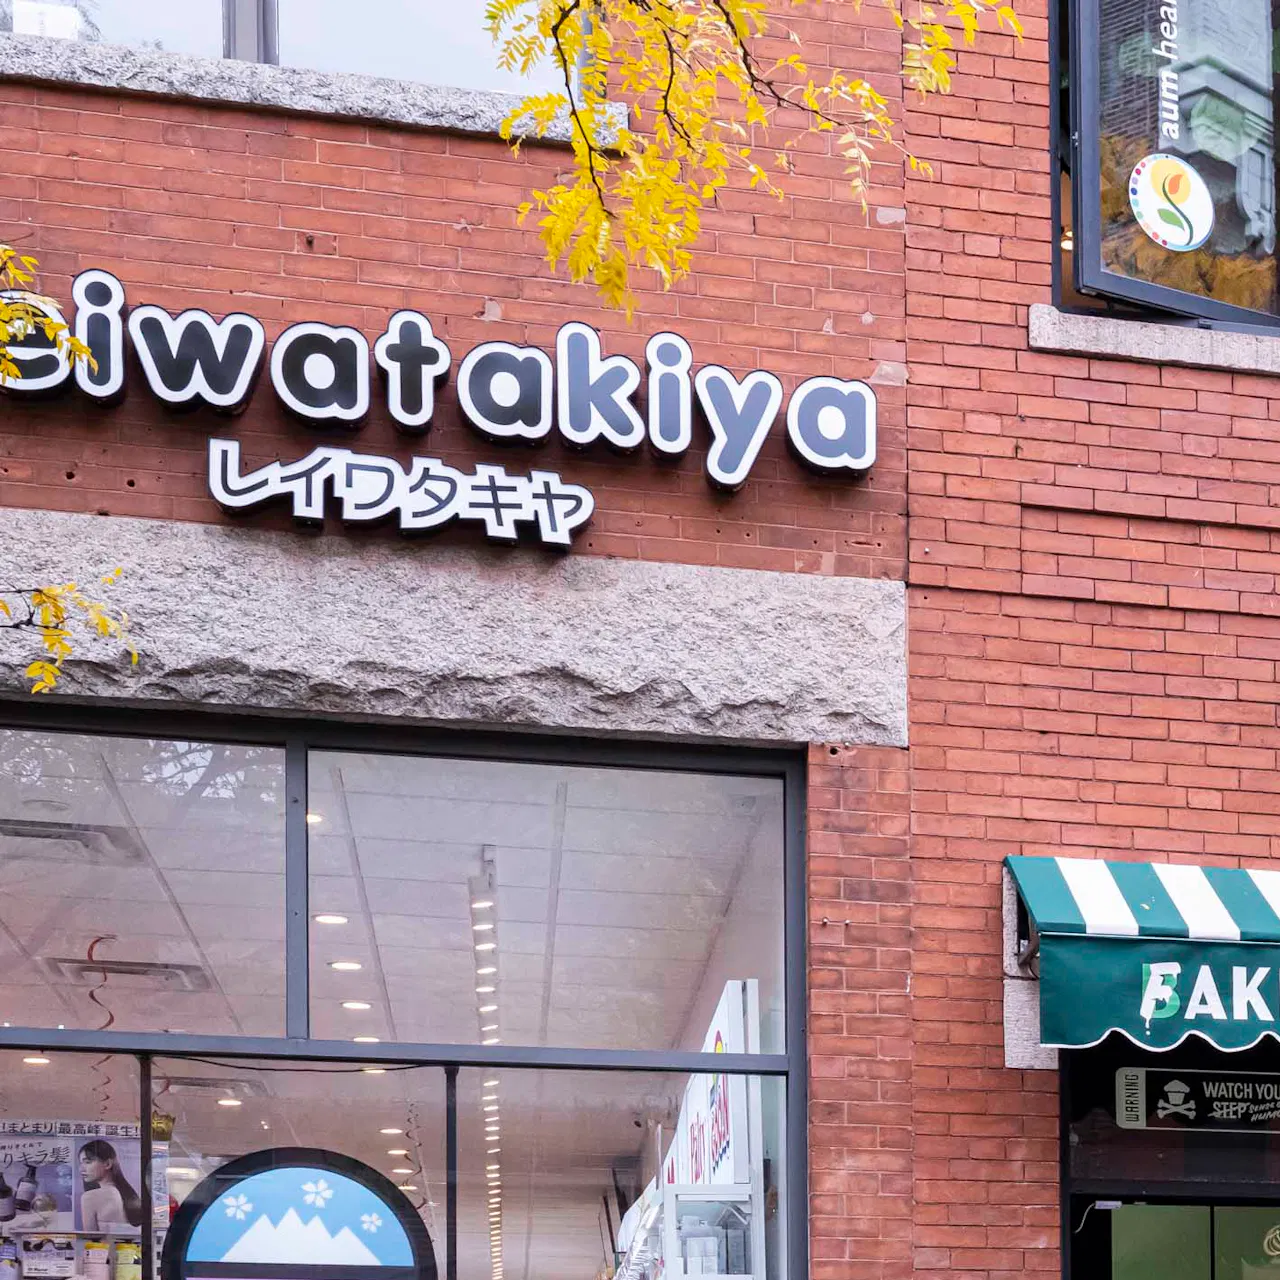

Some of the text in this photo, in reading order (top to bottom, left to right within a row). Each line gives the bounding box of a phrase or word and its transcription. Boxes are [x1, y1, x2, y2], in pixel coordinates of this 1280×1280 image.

[1160, 69, 1179, 140] aum
[212, 440, 595, 544] レイワタキヤ
[1124, 1074, 1140, 1123] WARNING
[1203, 1081, 1253, 1099] WATCH
[1210, 1101, 1248, 1119] STEP
